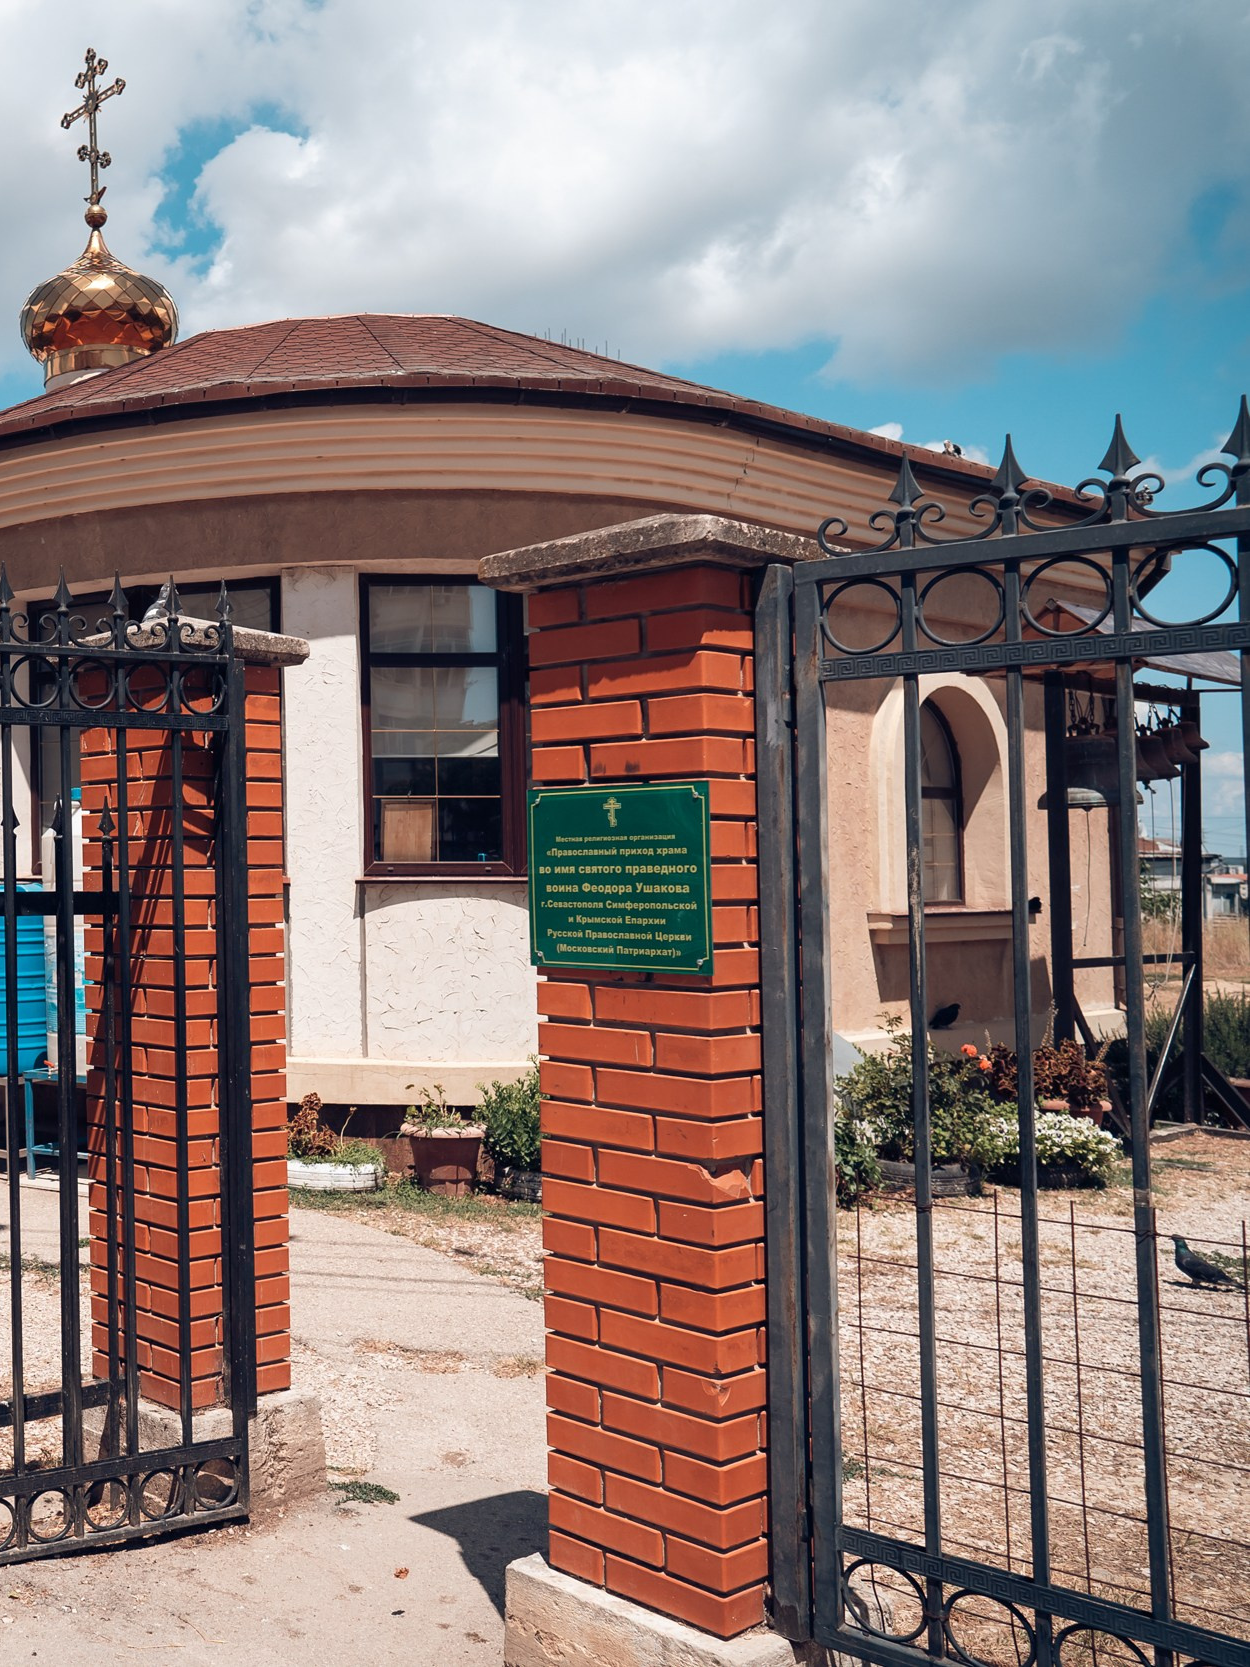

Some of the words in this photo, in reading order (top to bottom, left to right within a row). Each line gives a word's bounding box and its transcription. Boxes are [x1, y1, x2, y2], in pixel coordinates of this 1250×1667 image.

[547, 847, 617, 857] «Православный
[620, 848, 653, 856] приход
[657, 847, 687, 856] храма
[579, 865, 621, 873] святого
[626, 865, 697, 875] праведного
[546, 884, 578, 892] воина
[582, 883, 632, 894] Феодора
[636, 883, 689, 893] Ушакова
[541, 900, 603, 908] г.Севастополя
[606, 901, 697, 910] Симферопольской
[576, 915, 622, 925] Крымской
[625, 916, 666, 926] Епархии
[547, 929, 583, 938] Русской
[585, 930, 652, 940] Православной
[656, 932, 691, 941] Церкви
[557, 944, 614, 953] (Московский
[617, 946, 681, 957] Патриархат)»
